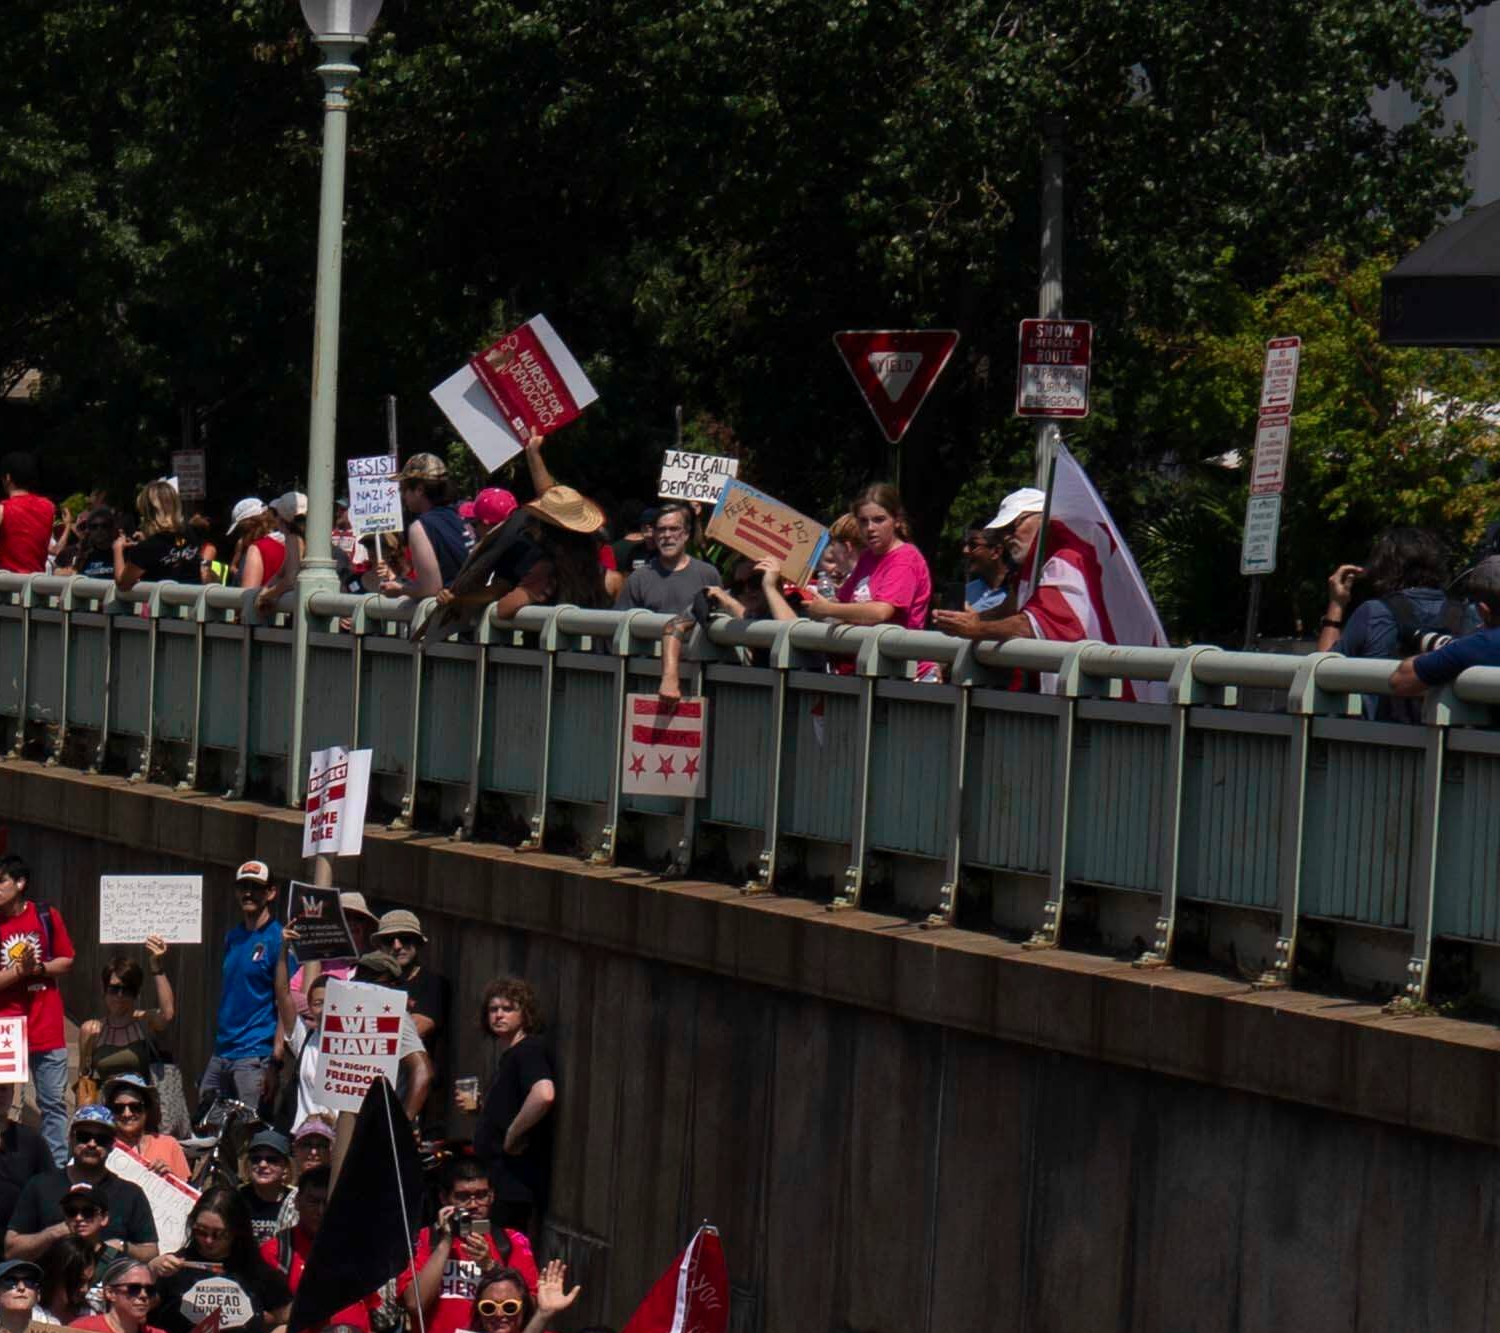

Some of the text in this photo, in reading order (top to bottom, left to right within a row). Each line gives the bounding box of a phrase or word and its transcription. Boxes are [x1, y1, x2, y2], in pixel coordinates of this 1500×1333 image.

[1036, 325, 1075, 340] SNOW
[1036, 350, 1074, 365] ROUTE
[877, 361, 914, 376] YIELD
[349, 458, 397, 474] RESIST
[664, 455, 733, 477] LAST CALL
[687, 472, 710, 485] FOR
